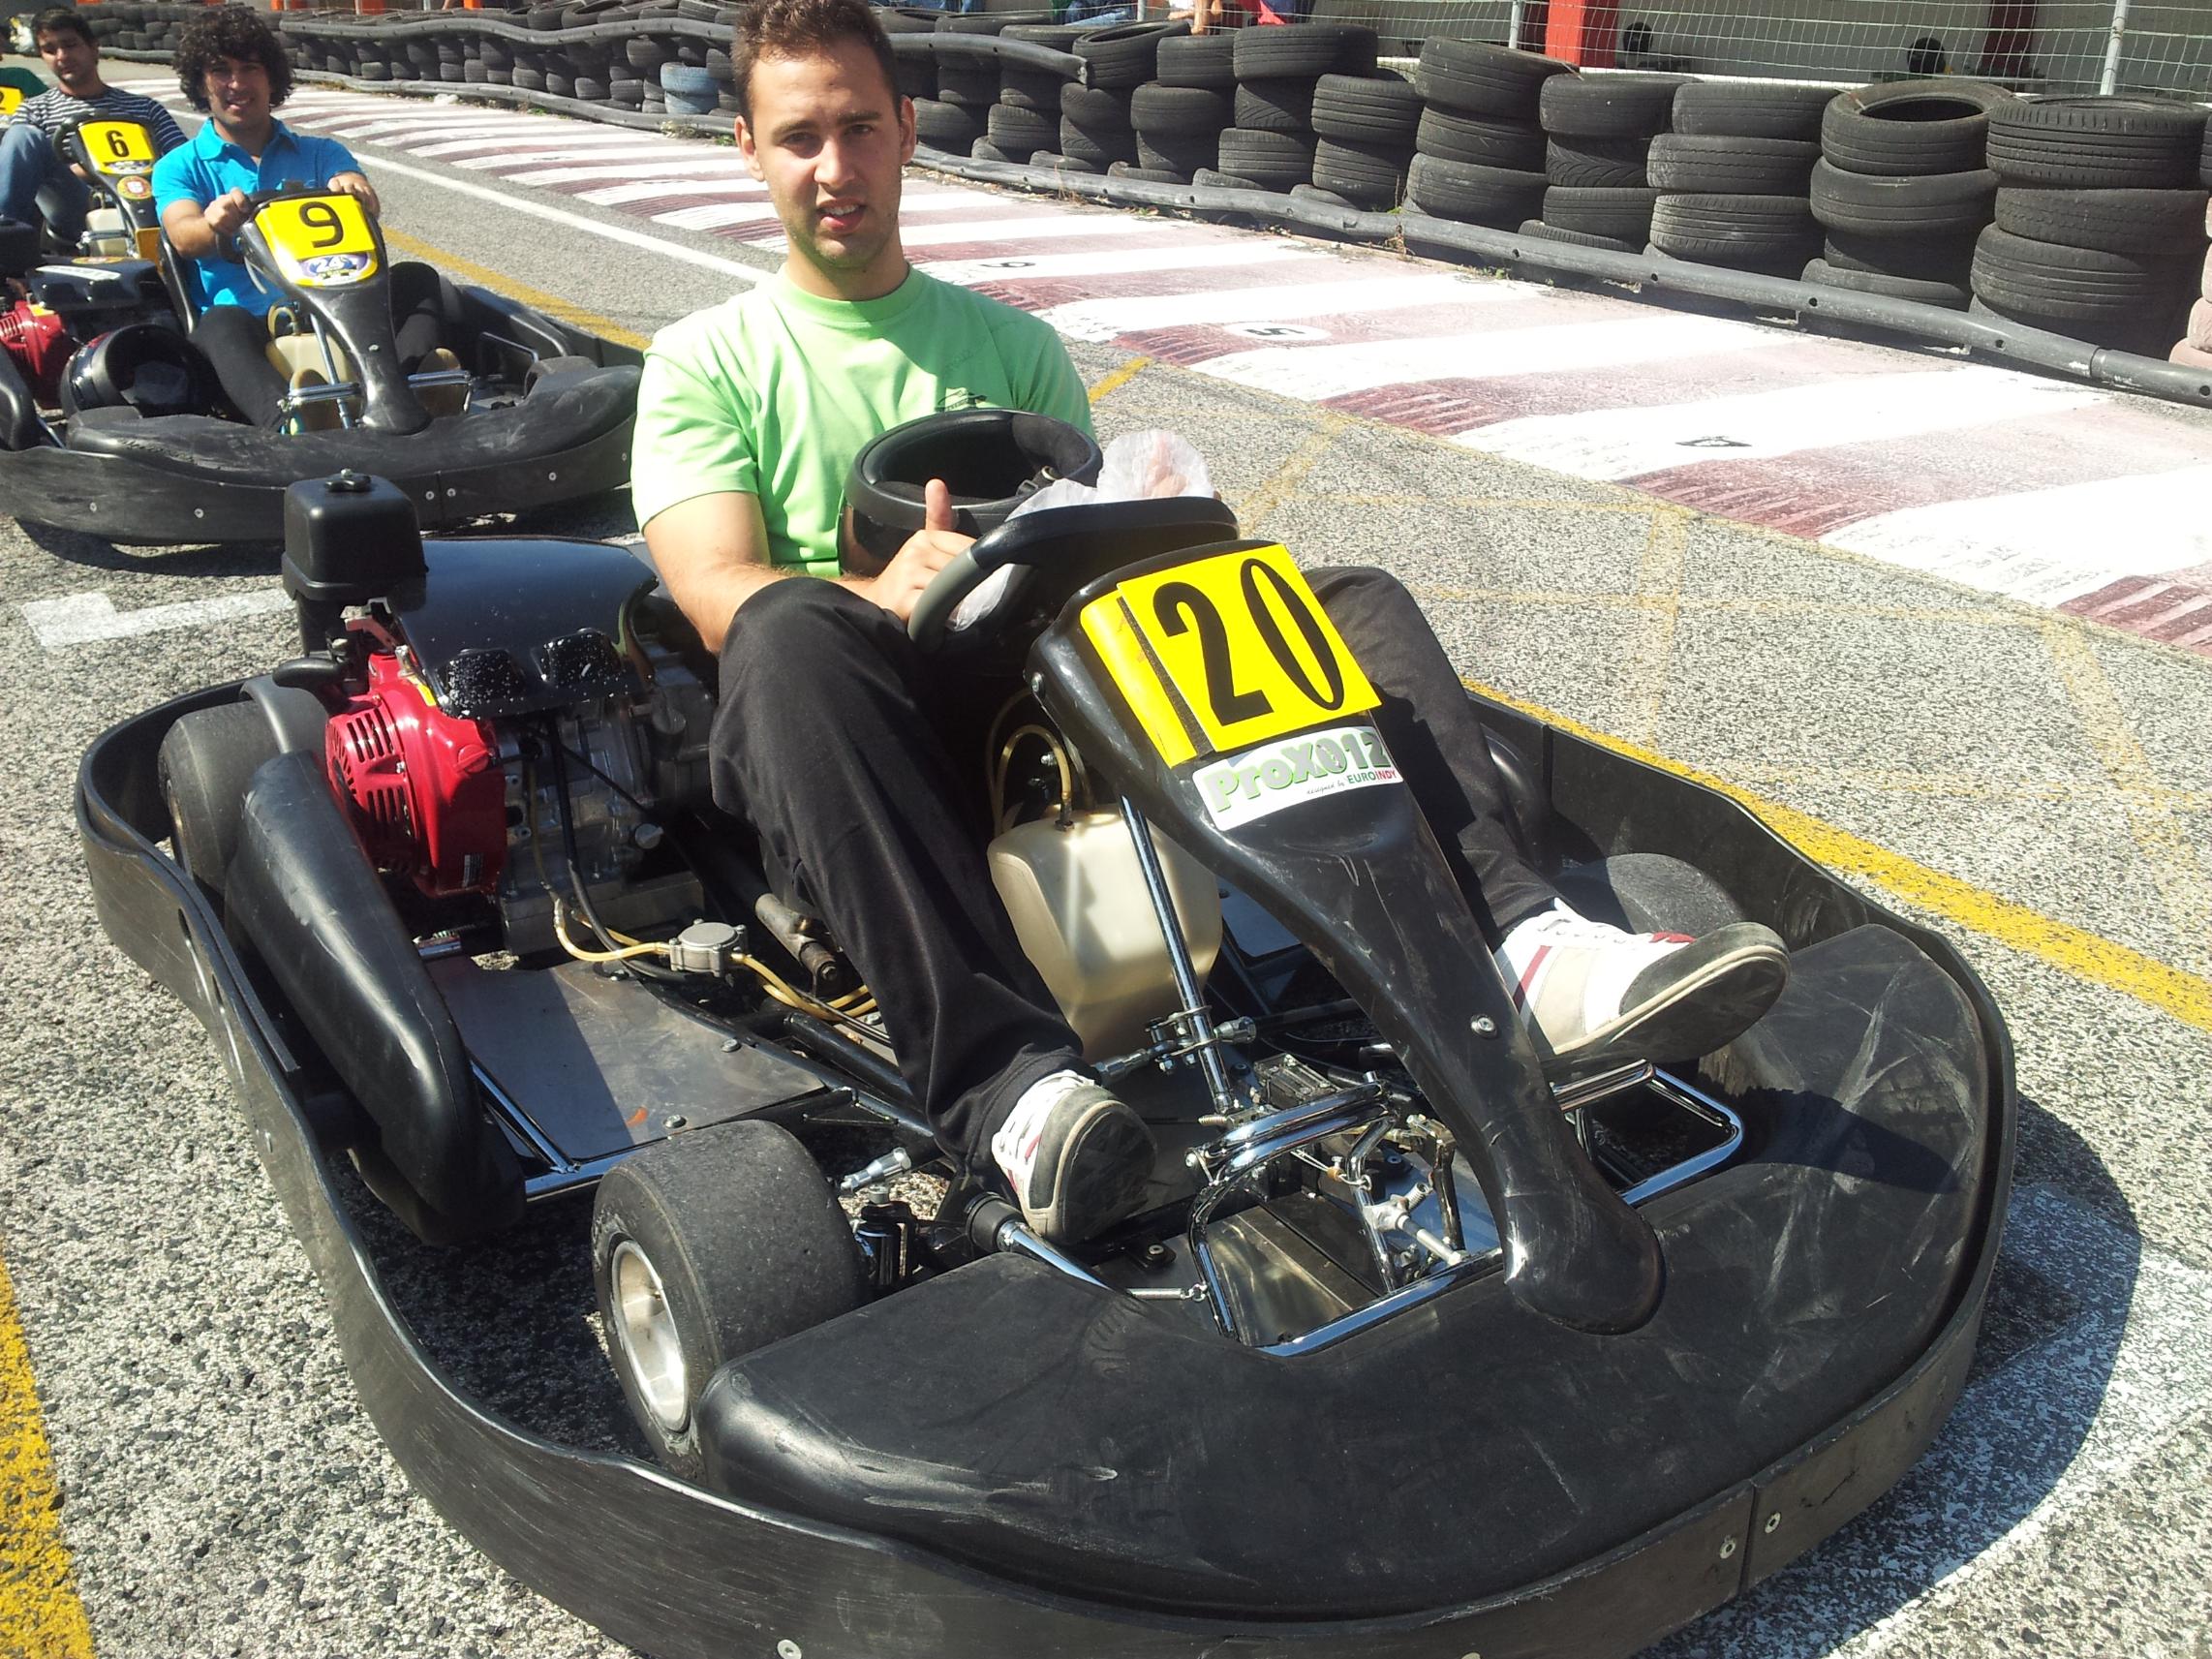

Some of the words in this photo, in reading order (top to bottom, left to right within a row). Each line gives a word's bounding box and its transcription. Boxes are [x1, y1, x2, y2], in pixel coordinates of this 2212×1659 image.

[106, 130, 129, 157] 6
[299, 200, 344, 248] 9
[1153, 558, 1345, 726] 20
